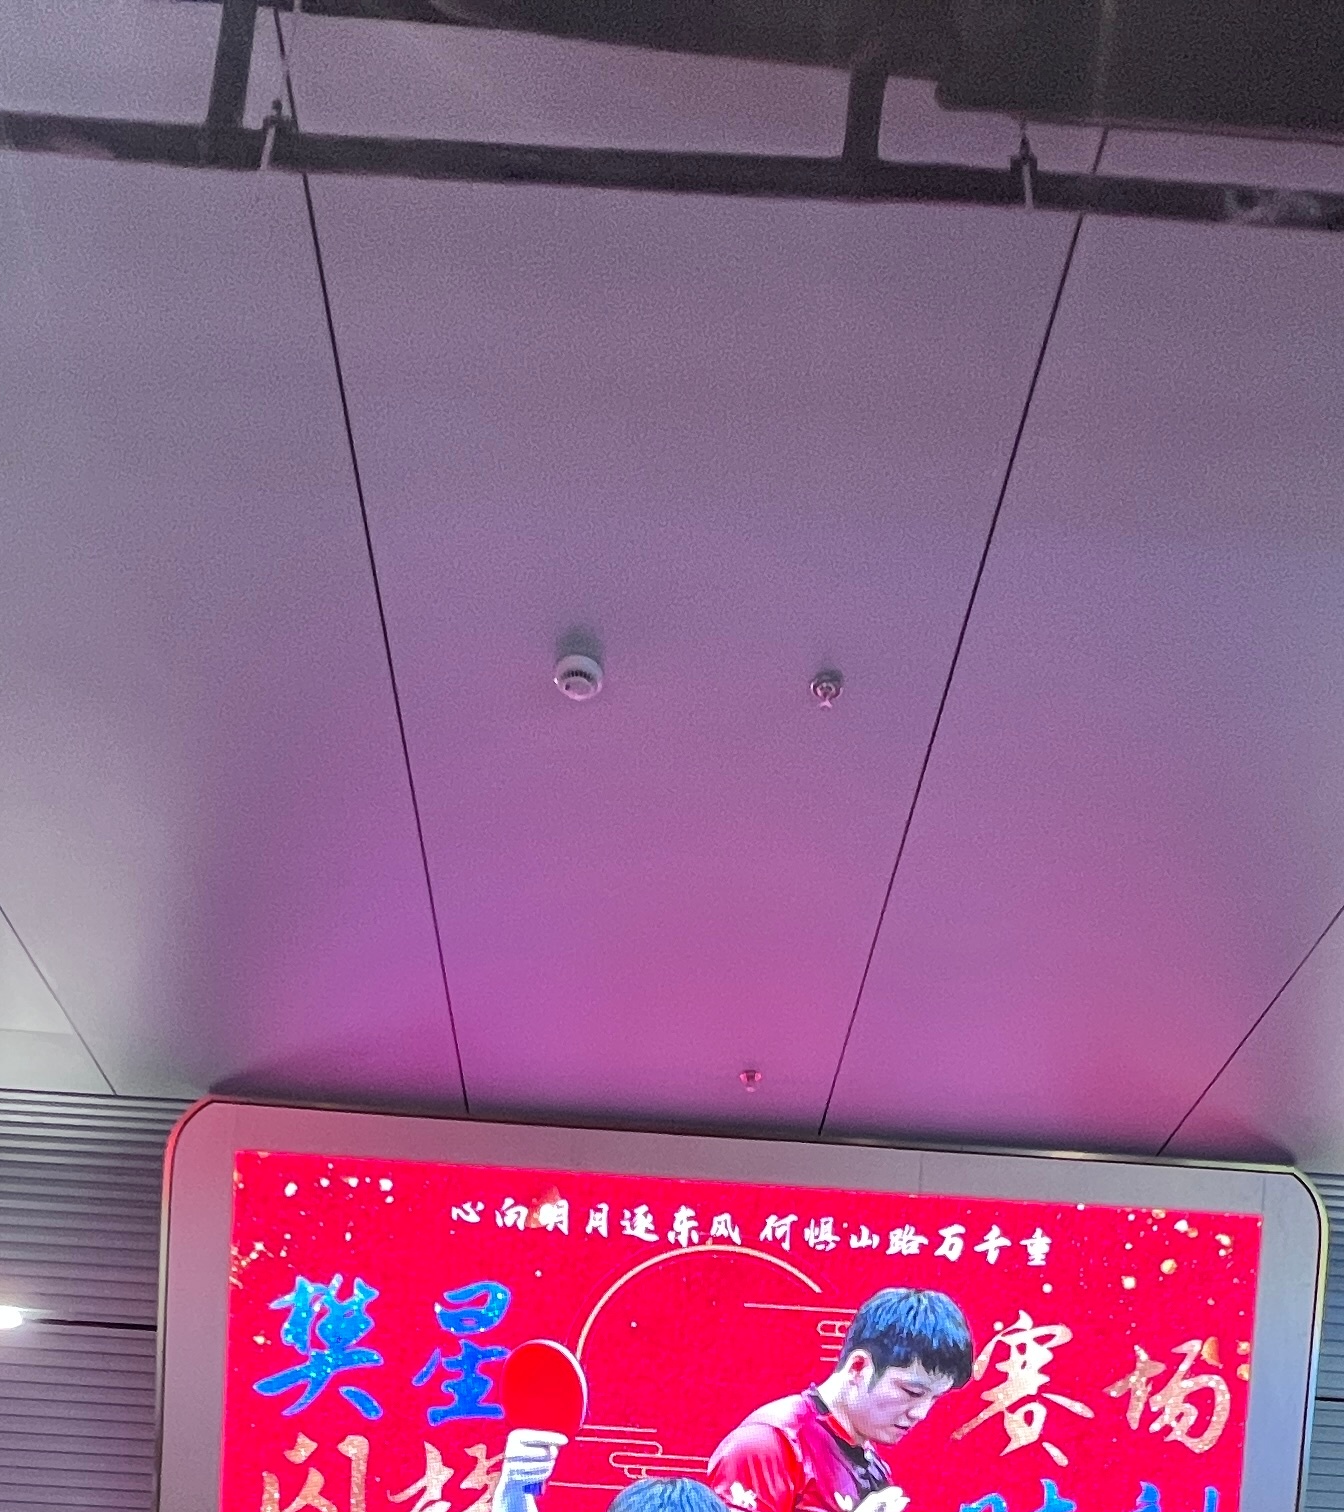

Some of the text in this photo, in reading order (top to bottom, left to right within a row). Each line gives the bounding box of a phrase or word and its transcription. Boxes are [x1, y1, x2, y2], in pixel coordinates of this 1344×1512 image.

[450, 1196, 1054, 1268] 心向明月逐东风 何惧山路万千重
[253, 1273, 512, 1427] 樊星
[950, 1309, 1232, 1468] 赛场
